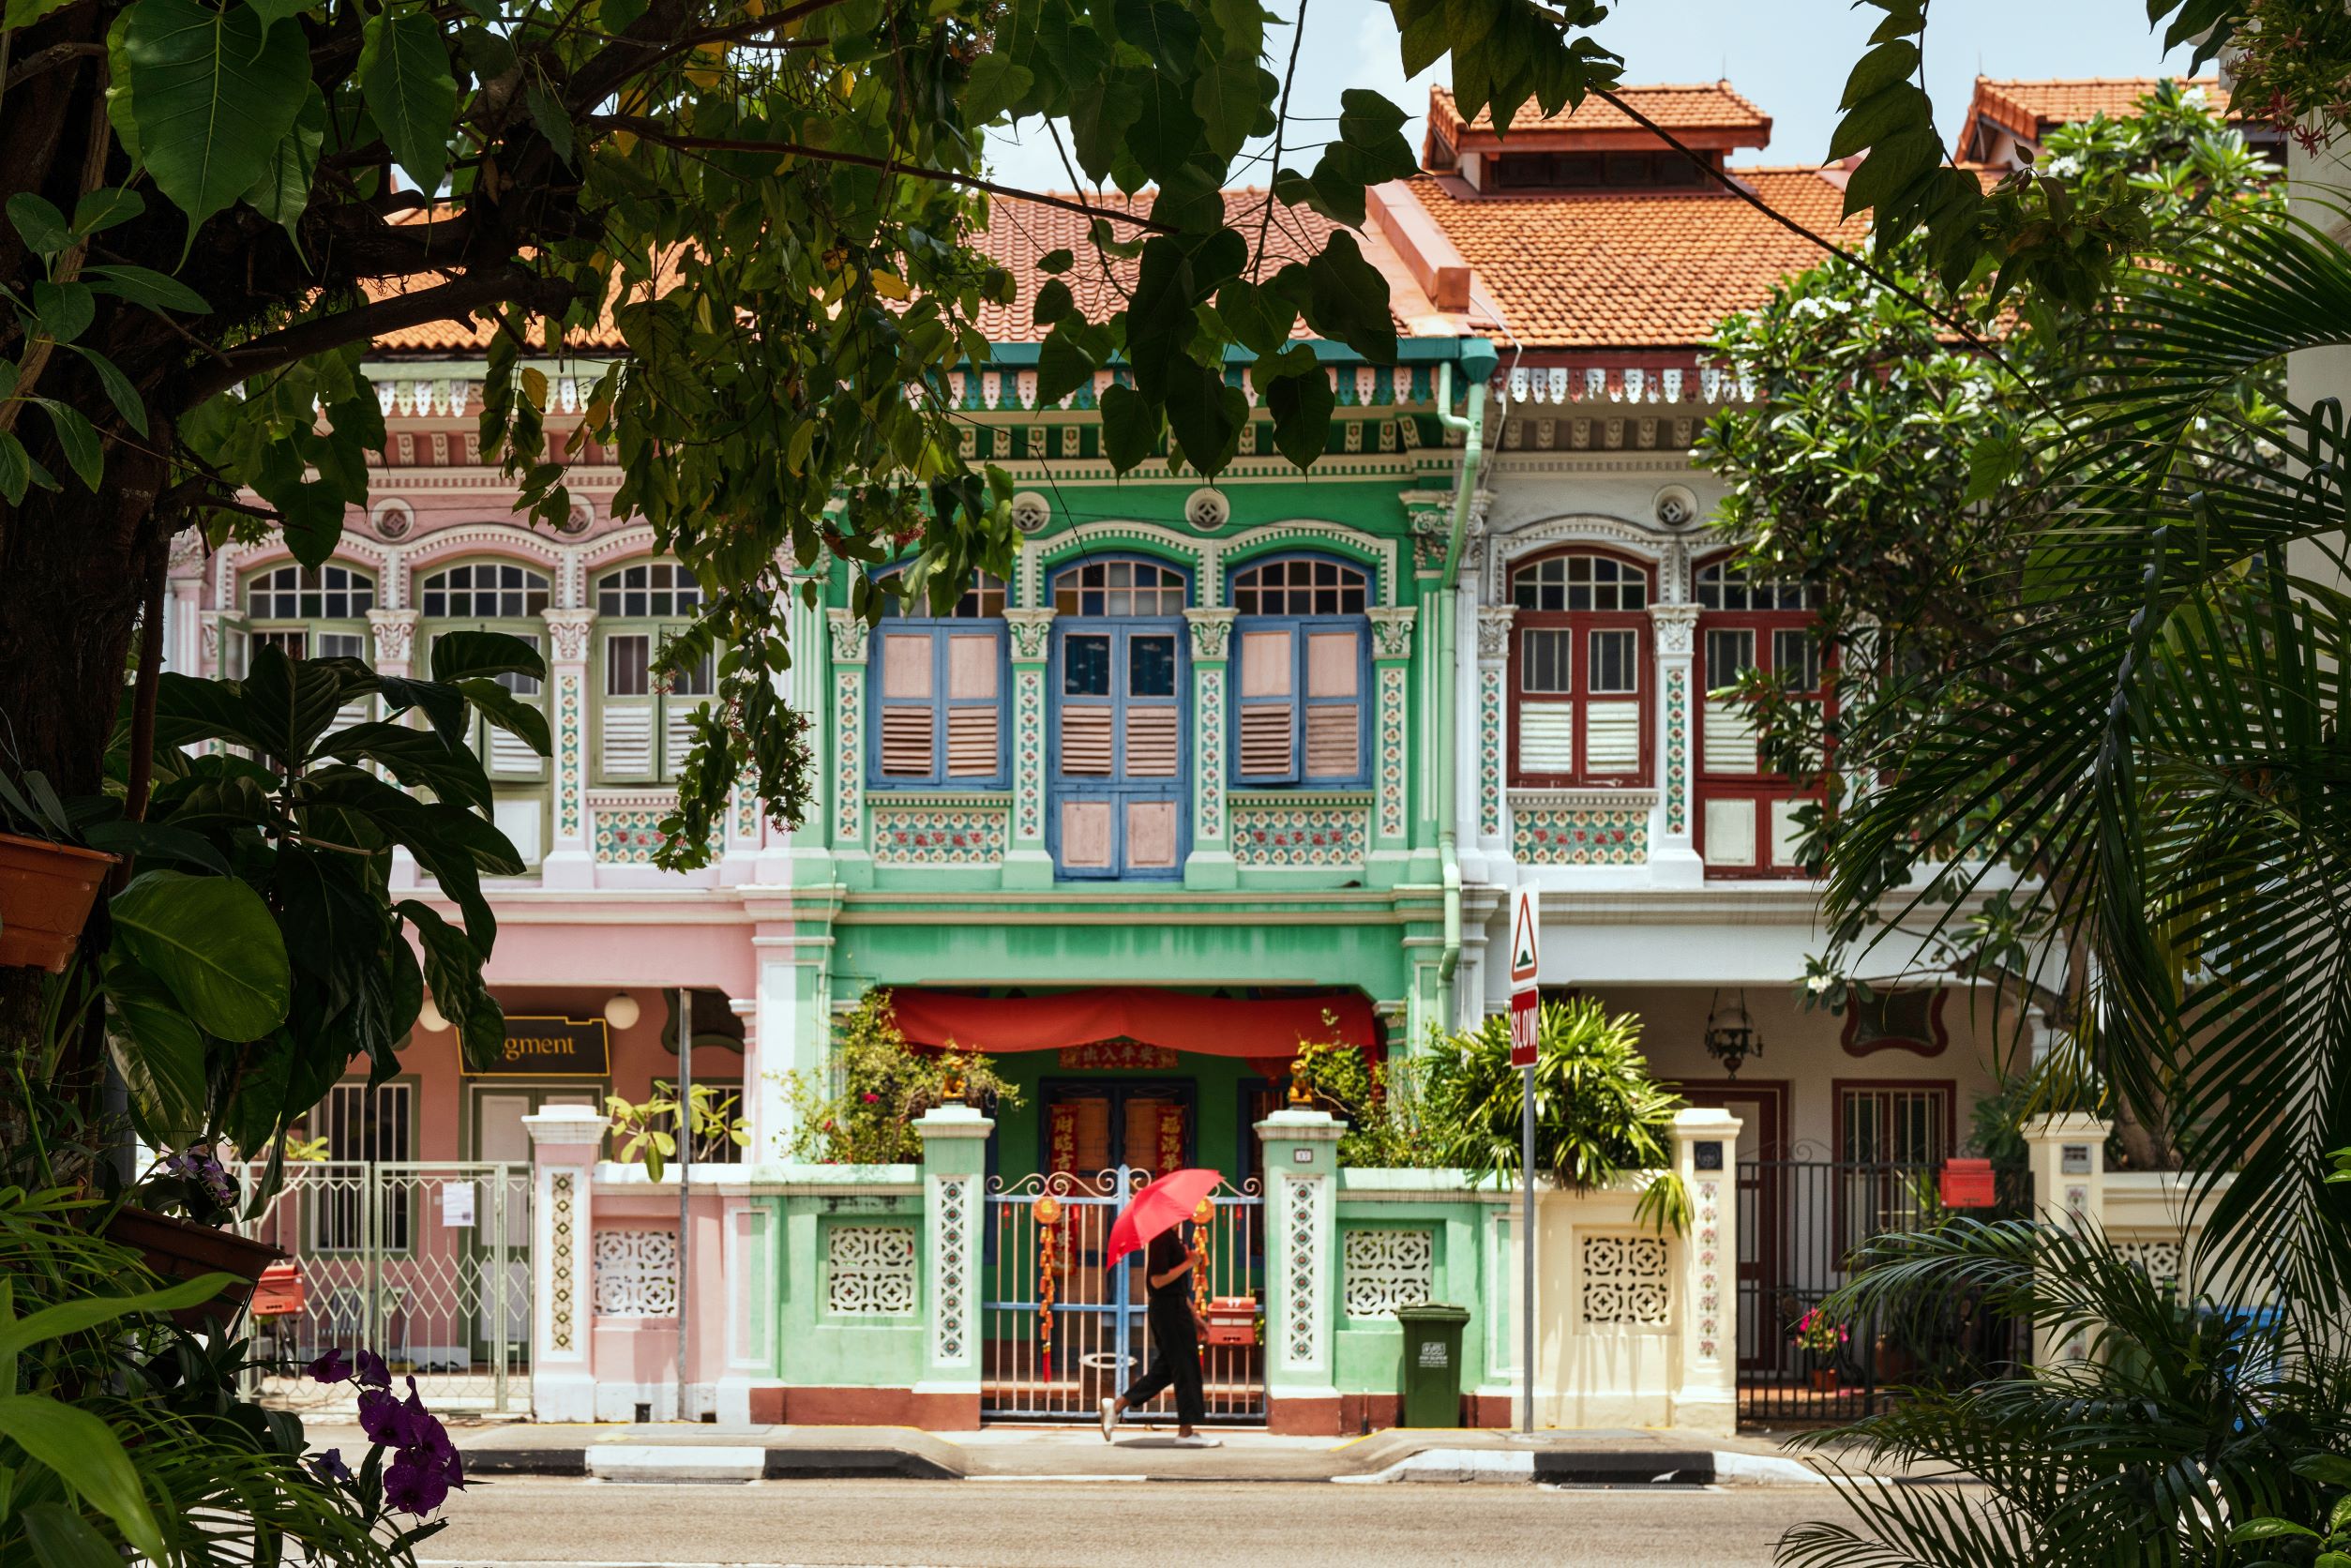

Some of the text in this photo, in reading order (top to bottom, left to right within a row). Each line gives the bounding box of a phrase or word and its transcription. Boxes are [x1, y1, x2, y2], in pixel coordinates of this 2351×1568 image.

[1512, 1007, 1537, 1049] SLOW
[505, 1035, 576, 1061] gment
[1083, 1046, 1154, 1063] 出入平安
